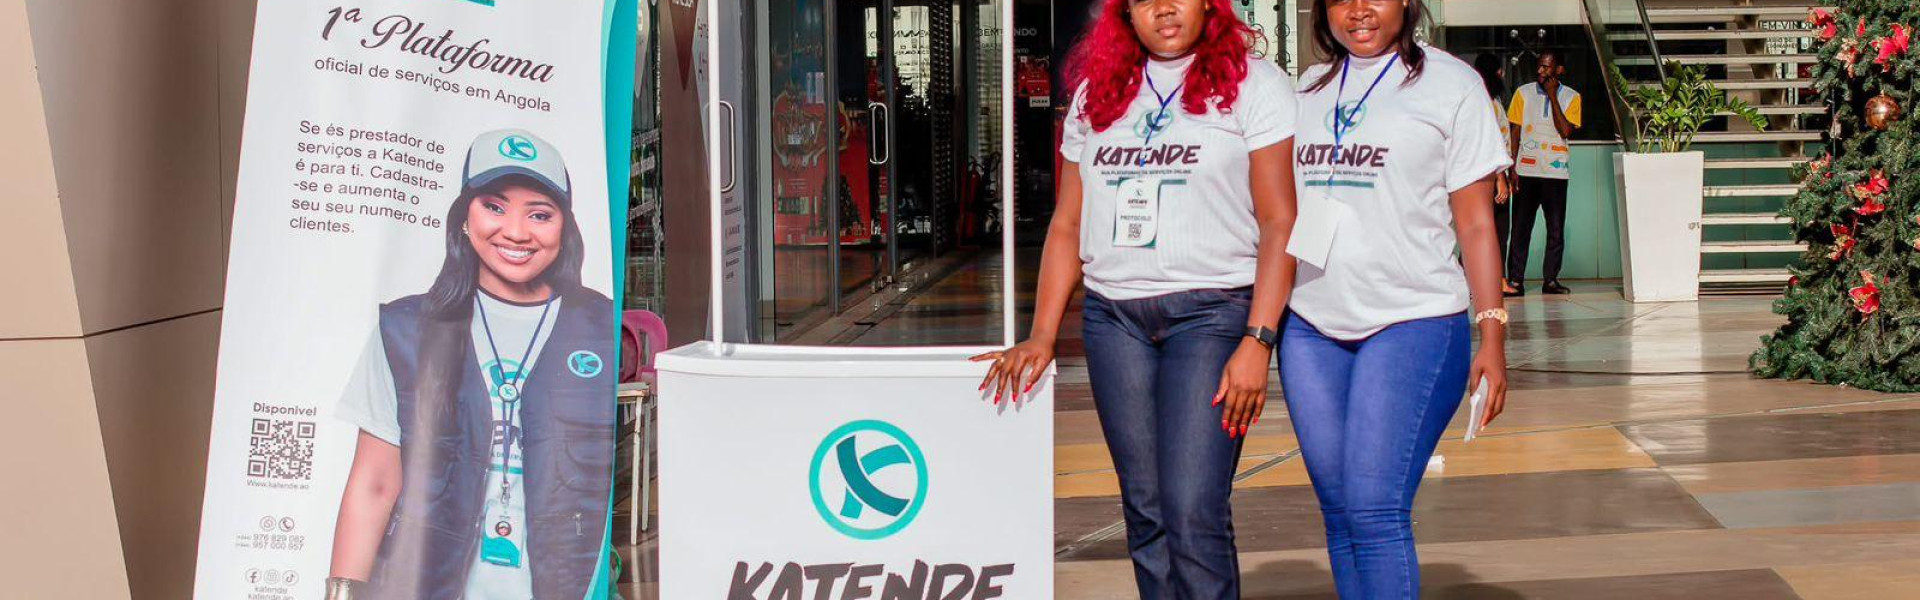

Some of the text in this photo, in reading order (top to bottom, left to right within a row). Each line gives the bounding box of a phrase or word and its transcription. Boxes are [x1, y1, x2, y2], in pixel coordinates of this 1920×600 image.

[322, 6, 554, 83] 1ª Plataforma
[314, 57, 551, 112] oficial de serviços em Angola
[299, 120, 445, 155] Se és prestador de
[297, 142, 445, 173] serviços a Katende
[1093, 143, 1201, 167] KATENDE
[1296, 143, 1389, 167] KATENDE
[295, 158, 444, 191] é para ti. Cadastra-
[293, 180, 420, 205] -se e aumenta o
[289, 217, 355, 233] clientes.
[291, 198, 441, 229] seu seu numero de
[253, 402, 317, 416] Disponivel
[727, 559, 1015, 600] KATENDE
